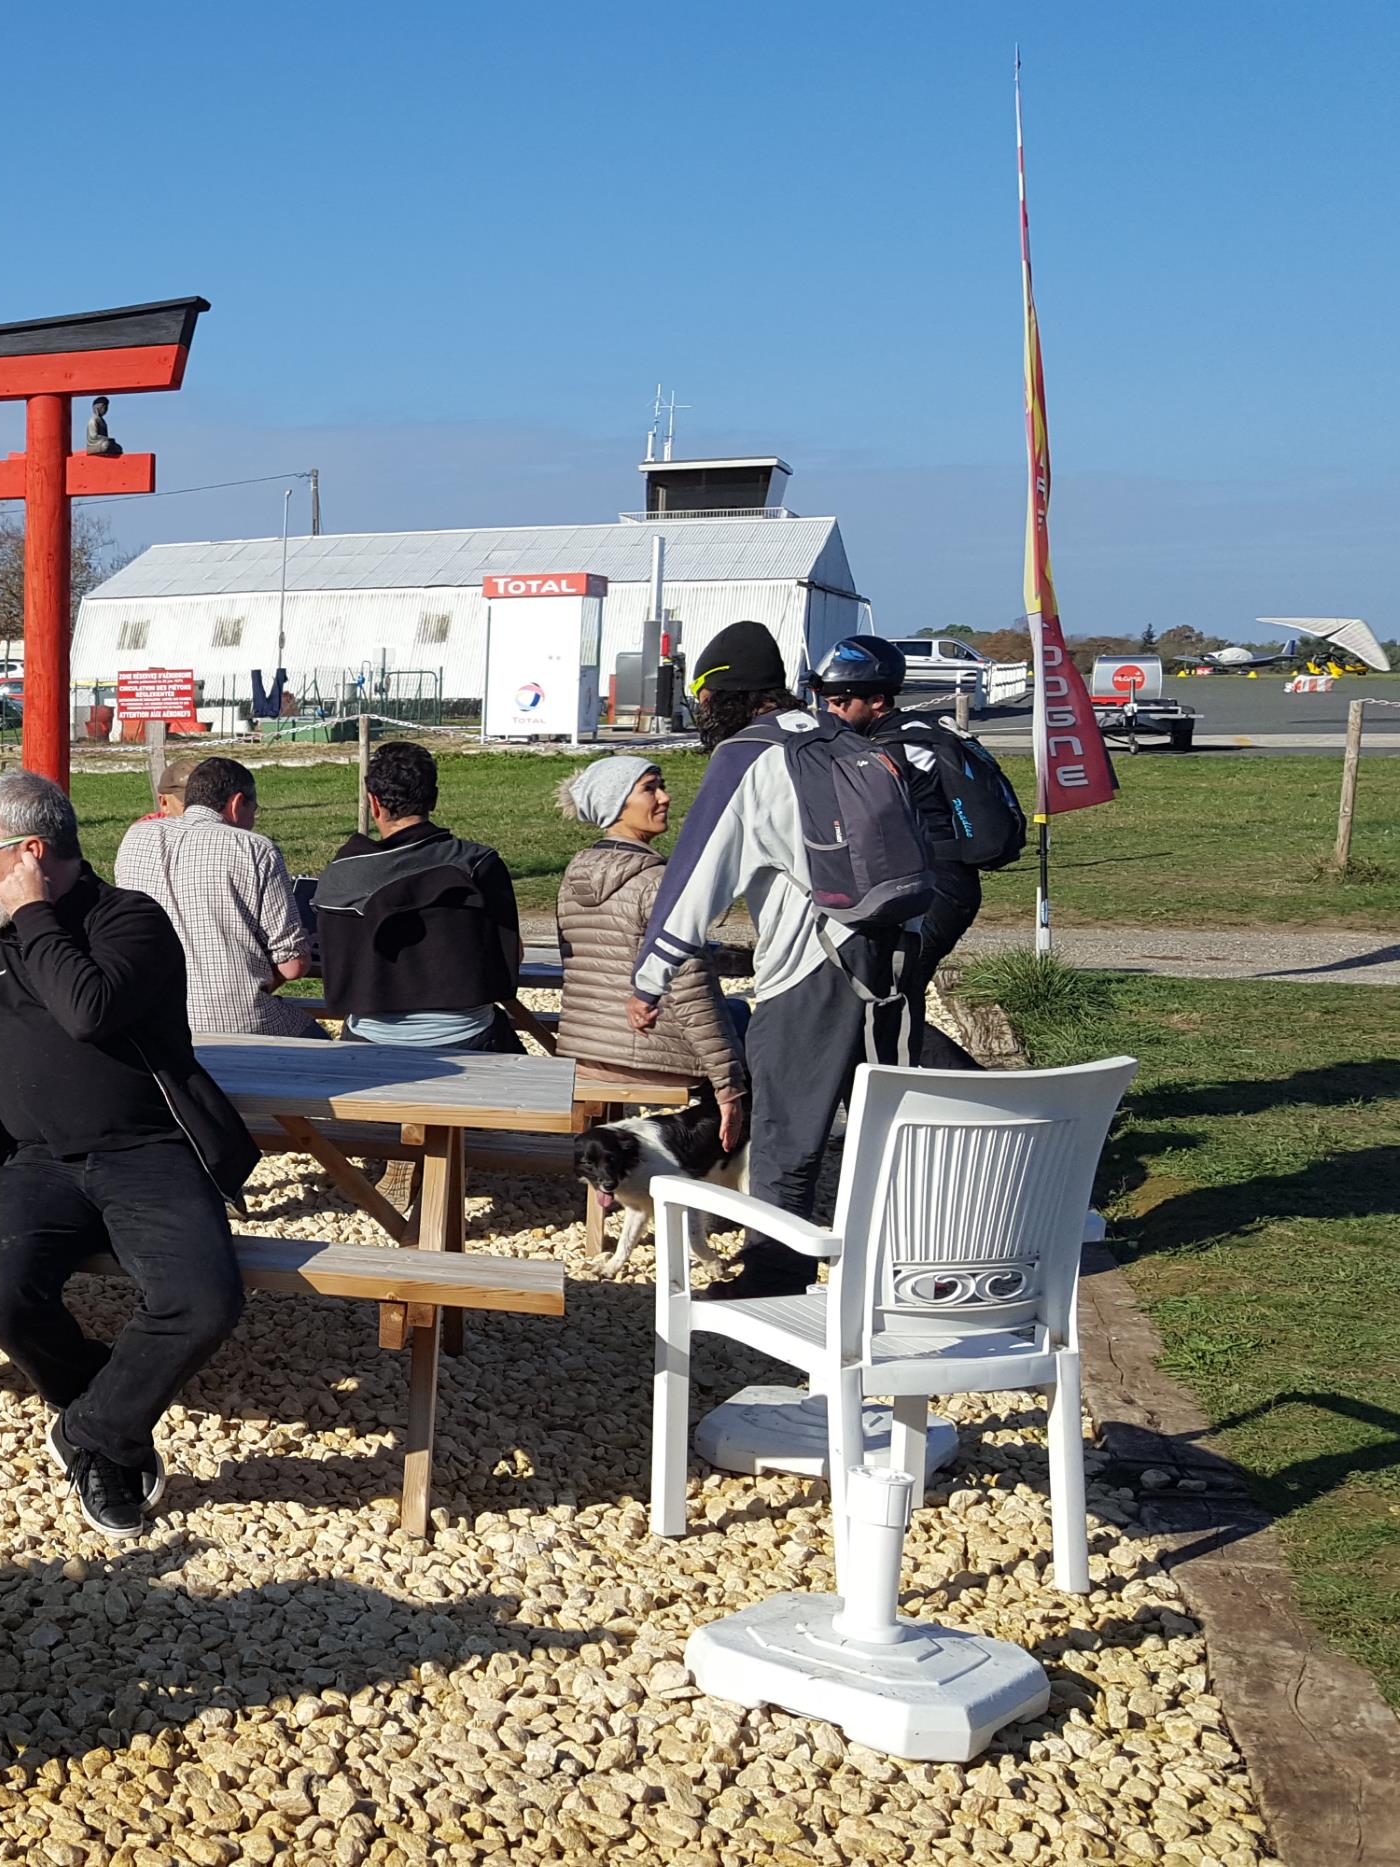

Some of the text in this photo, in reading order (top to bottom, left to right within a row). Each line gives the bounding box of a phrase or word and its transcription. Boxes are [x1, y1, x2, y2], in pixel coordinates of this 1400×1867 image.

[492, 578, 577, 594] TOTAL
[512, 716, 547, 725] TOTAL
[952, 798, 974, 838] Paradise
